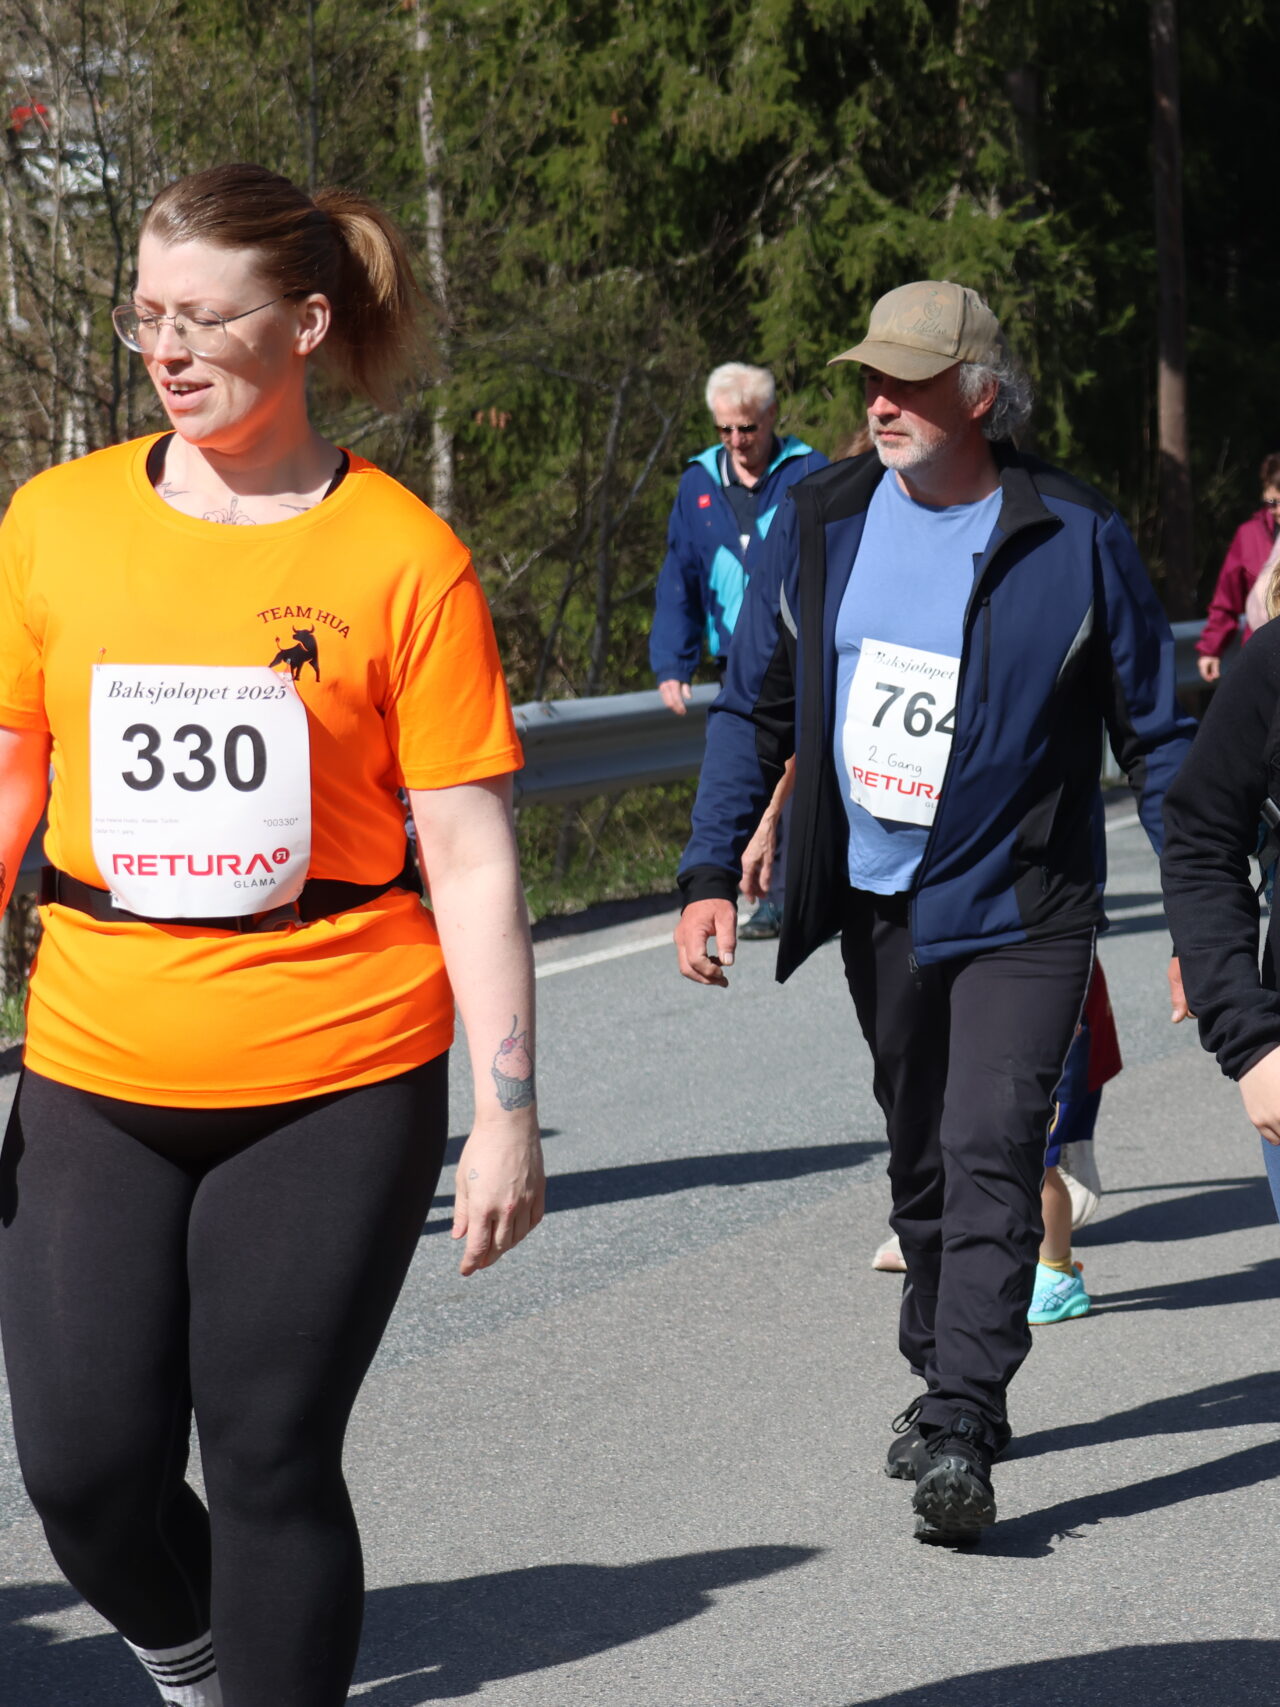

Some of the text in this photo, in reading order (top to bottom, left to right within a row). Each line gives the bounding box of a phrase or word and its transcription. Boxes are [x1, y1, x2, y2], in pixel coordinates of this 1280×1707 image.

[256, 605, 351, 639] TEAM HUA
[107, 680, 288, 705] Baksjøløpet 2025
[121, 723, 268, 792] 330
[887, 753, 922, 778] Gang
[112, 853, 274, 876] RETURA
